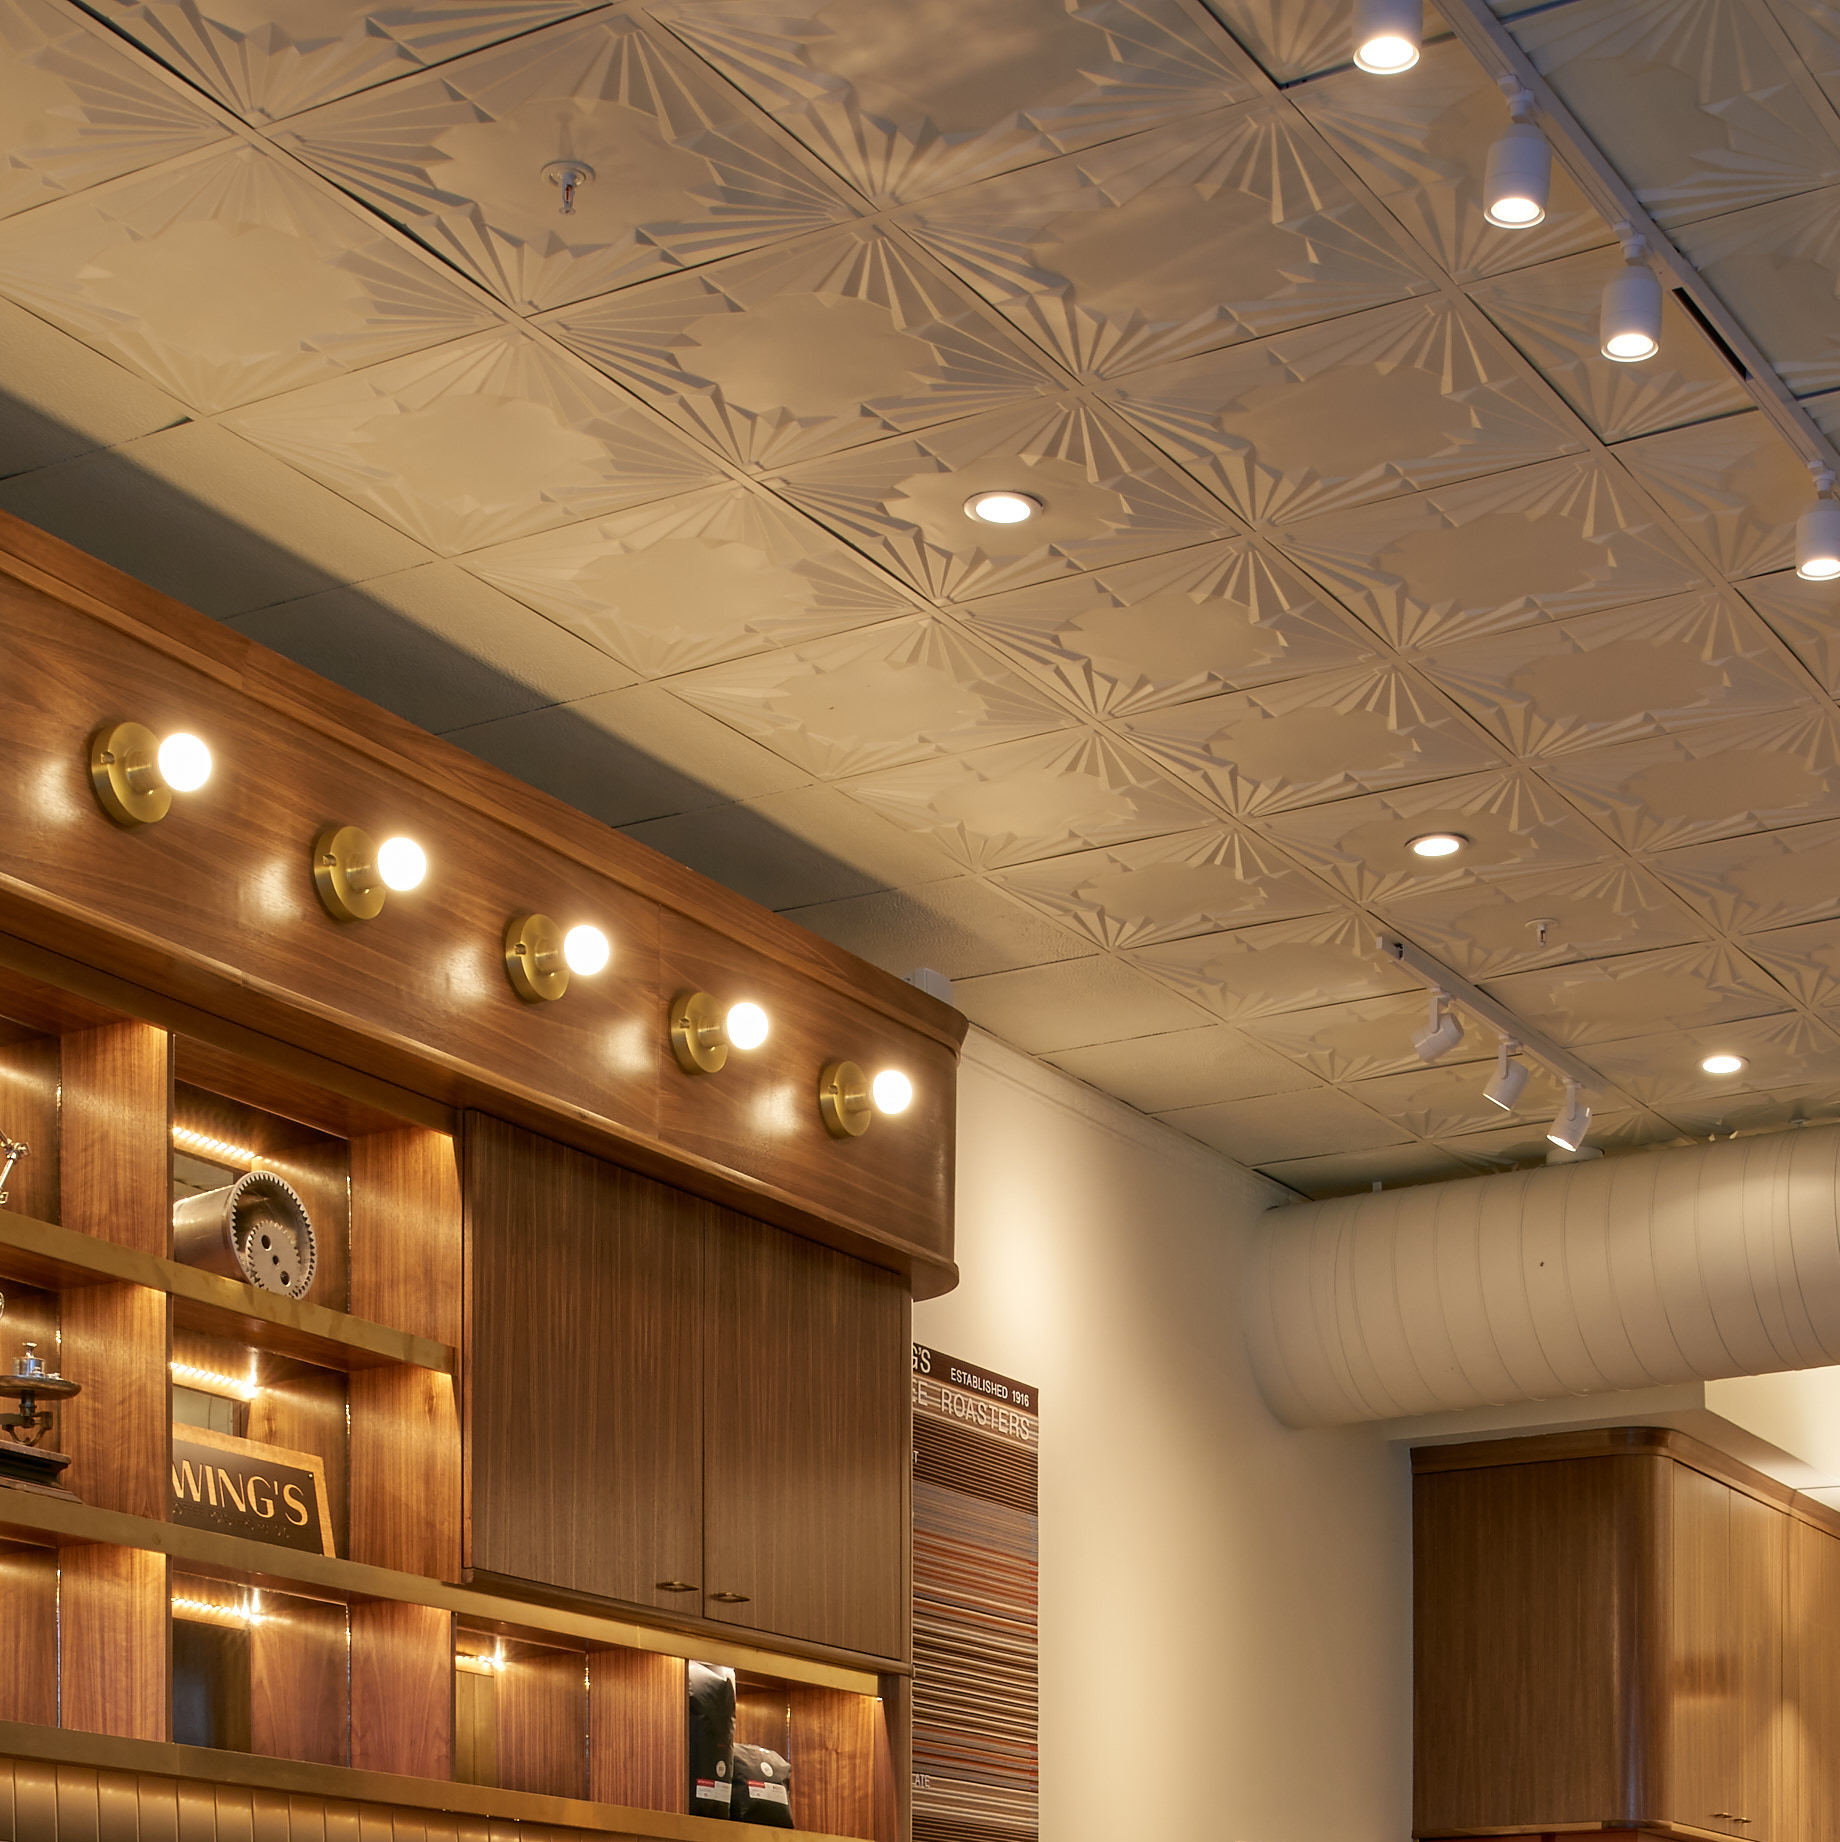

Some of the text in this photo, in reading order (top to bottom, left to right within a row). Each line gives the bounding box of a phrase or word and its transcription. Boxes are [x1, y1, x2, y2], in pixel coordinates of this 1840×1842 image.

[951, 1367, 1030, 1407] ESTABLISHED 1916
[941, 1388, 1030, 1440] ROASTERS
[172, 1460, 308, 1526] WING'S
